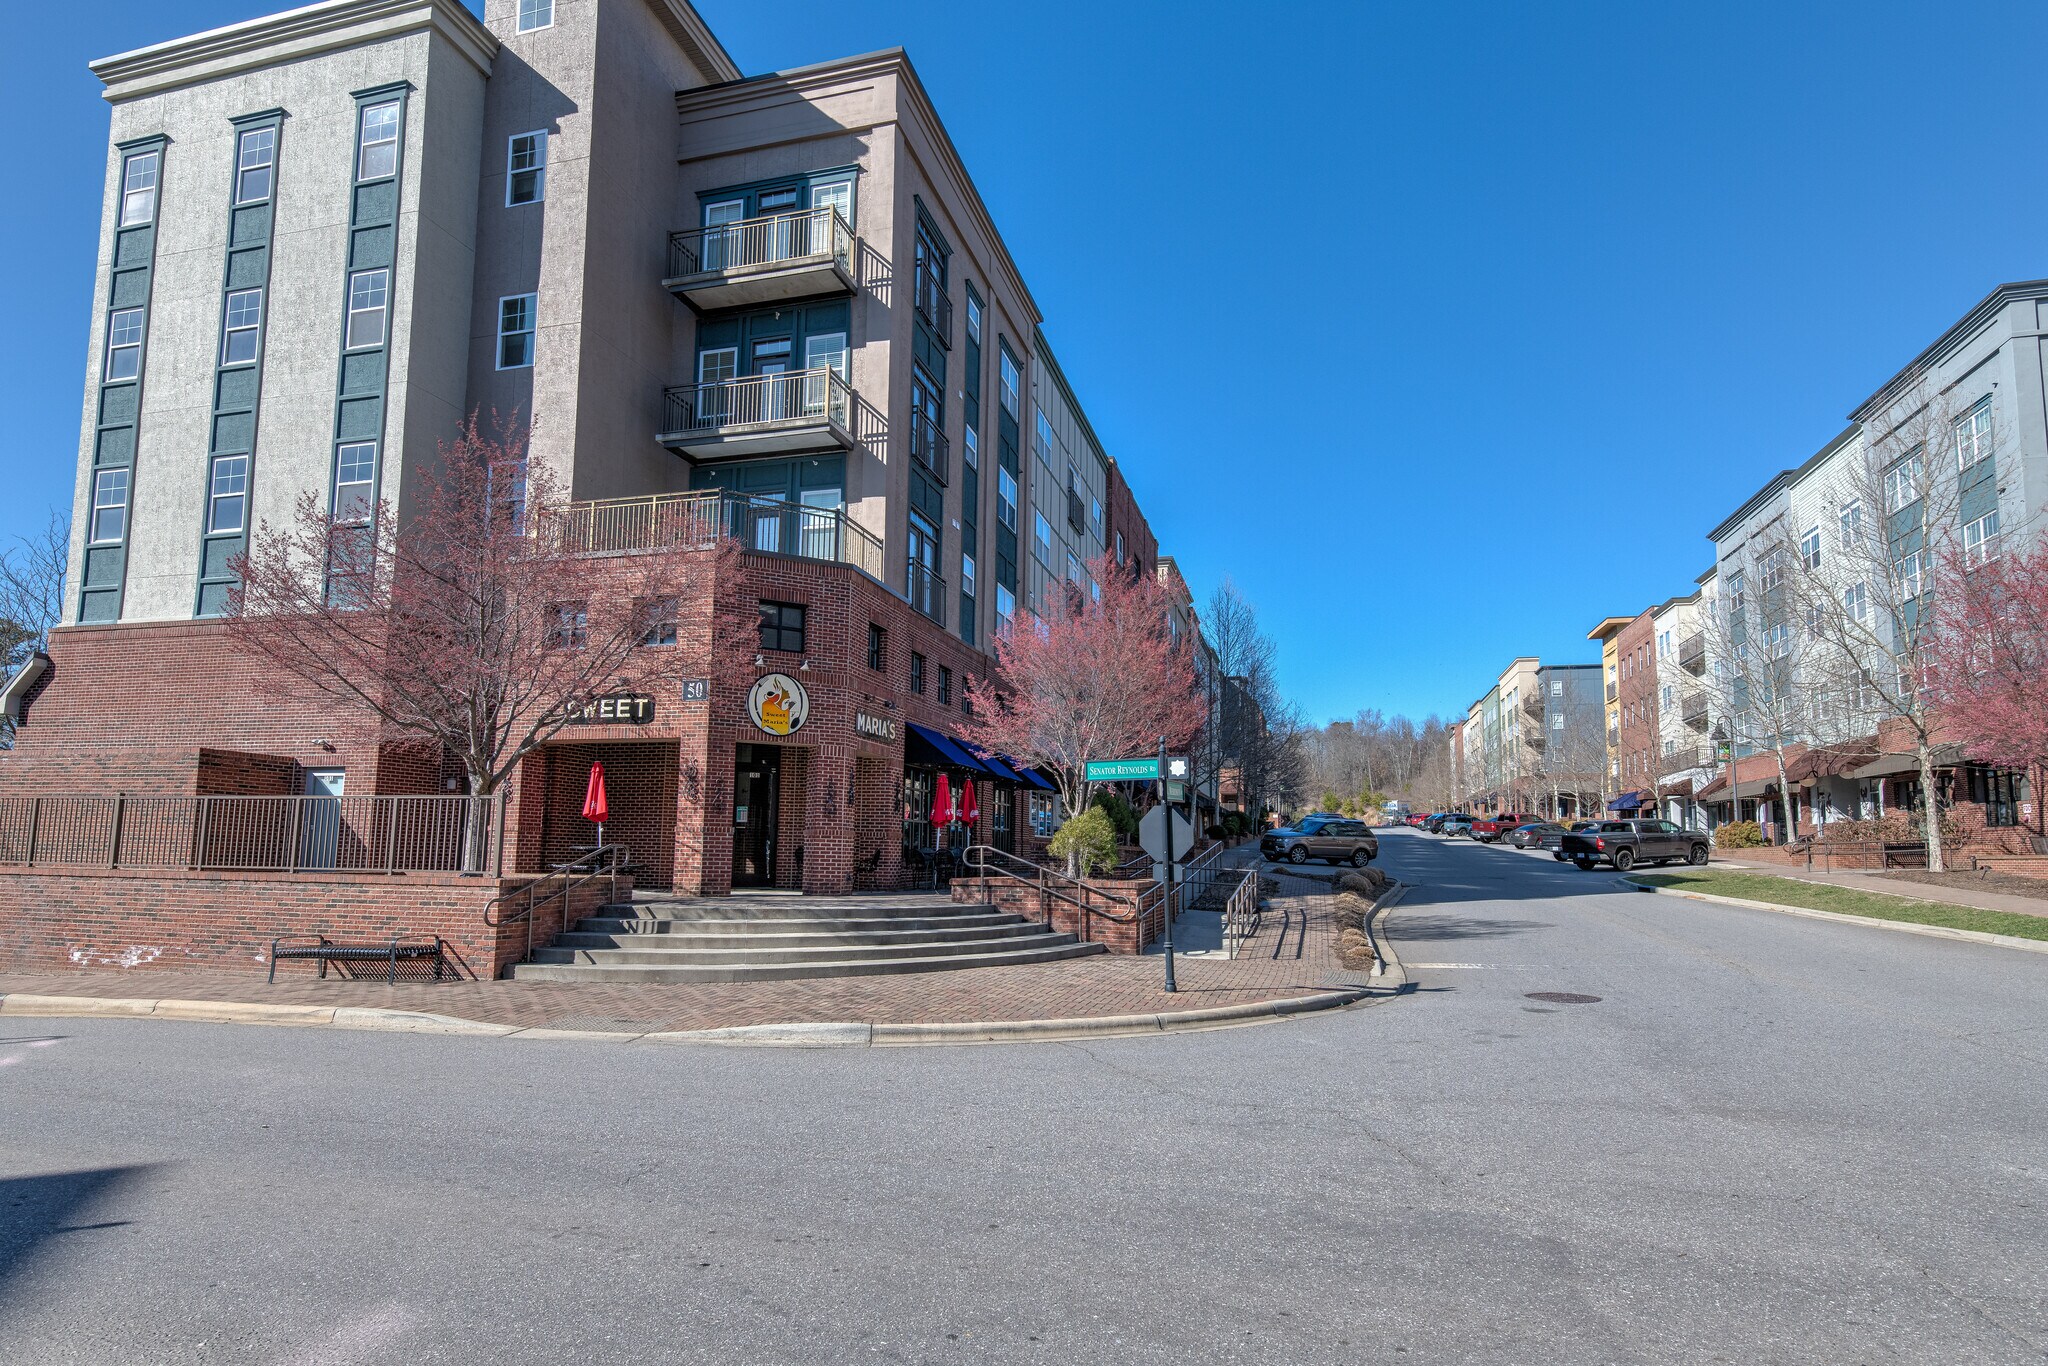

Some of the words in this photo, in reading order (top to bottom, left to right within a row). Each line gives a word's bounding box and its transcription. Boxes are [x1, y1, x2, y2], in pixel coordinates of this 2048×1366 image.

[687, 682, 703, 698] 50
[857, 712, 896, 740] MARIA'S
[1089, 766, 1116, 776] SENATOR
[1117, 765, 1148, 775] REYNOLDS
